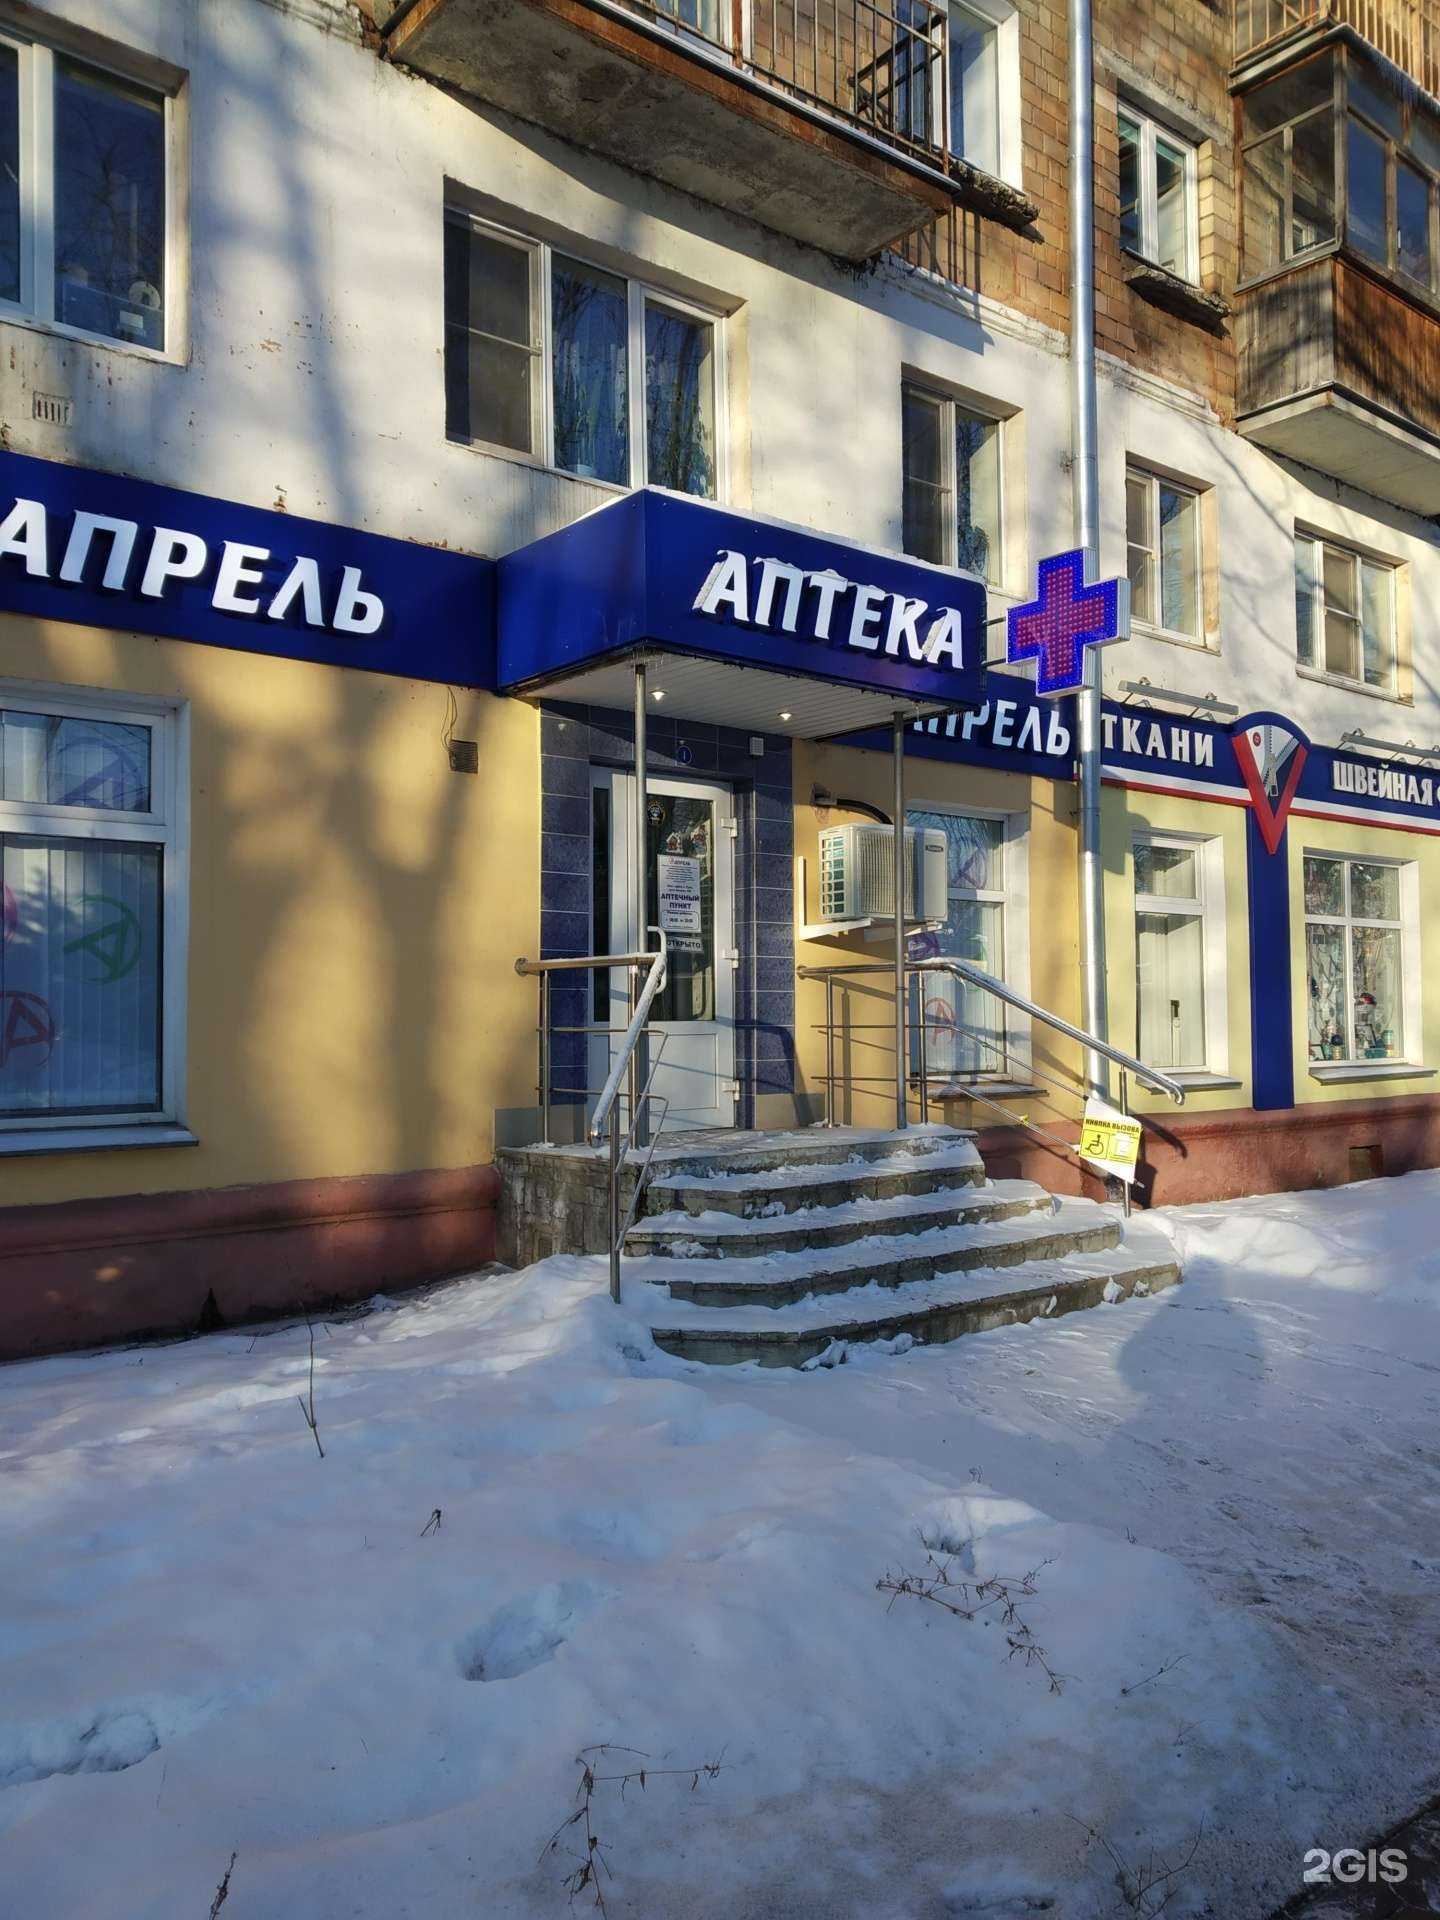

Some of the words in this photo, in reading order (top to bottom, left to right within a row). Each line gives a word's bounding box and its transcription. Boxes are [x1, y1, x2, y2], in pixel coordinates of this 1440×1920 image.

[0, 498, 384, 634] АПРЕЛЬ
[692, 550, 964, 670] АПТЕКА
[1101, 712, 1214, 768] ТКАНИ
[1333, 760, 1433, 806] ШВЕЙНАЯ
[661, 893, 700, 902] АПТЕЧНЫЙ
[669, 902, 692, 910] ПУНКТ
